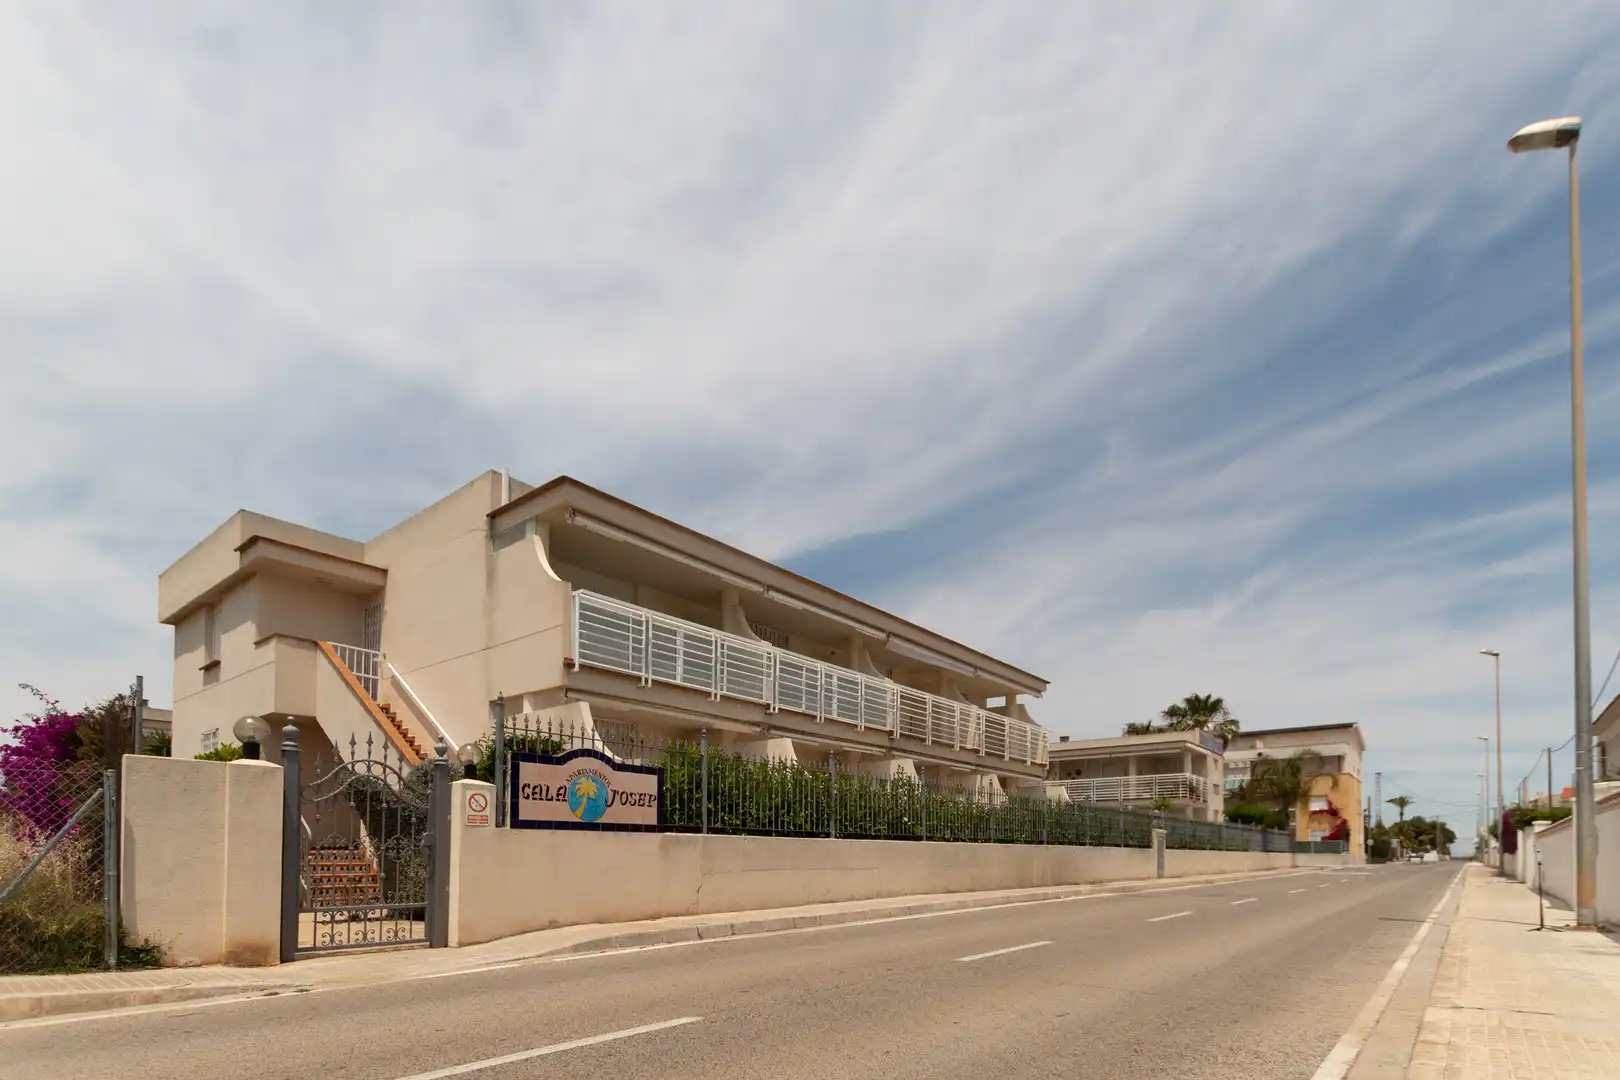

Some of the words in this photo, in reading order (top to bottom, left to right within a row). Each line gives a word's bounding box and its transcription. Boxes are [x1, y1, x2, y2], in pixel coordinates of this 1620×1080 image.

[565, 768, 612, 788] APARTAMENTOS
[521, 783, 568, 802] CALA
[605, 789, 657, 808] JOSEP
